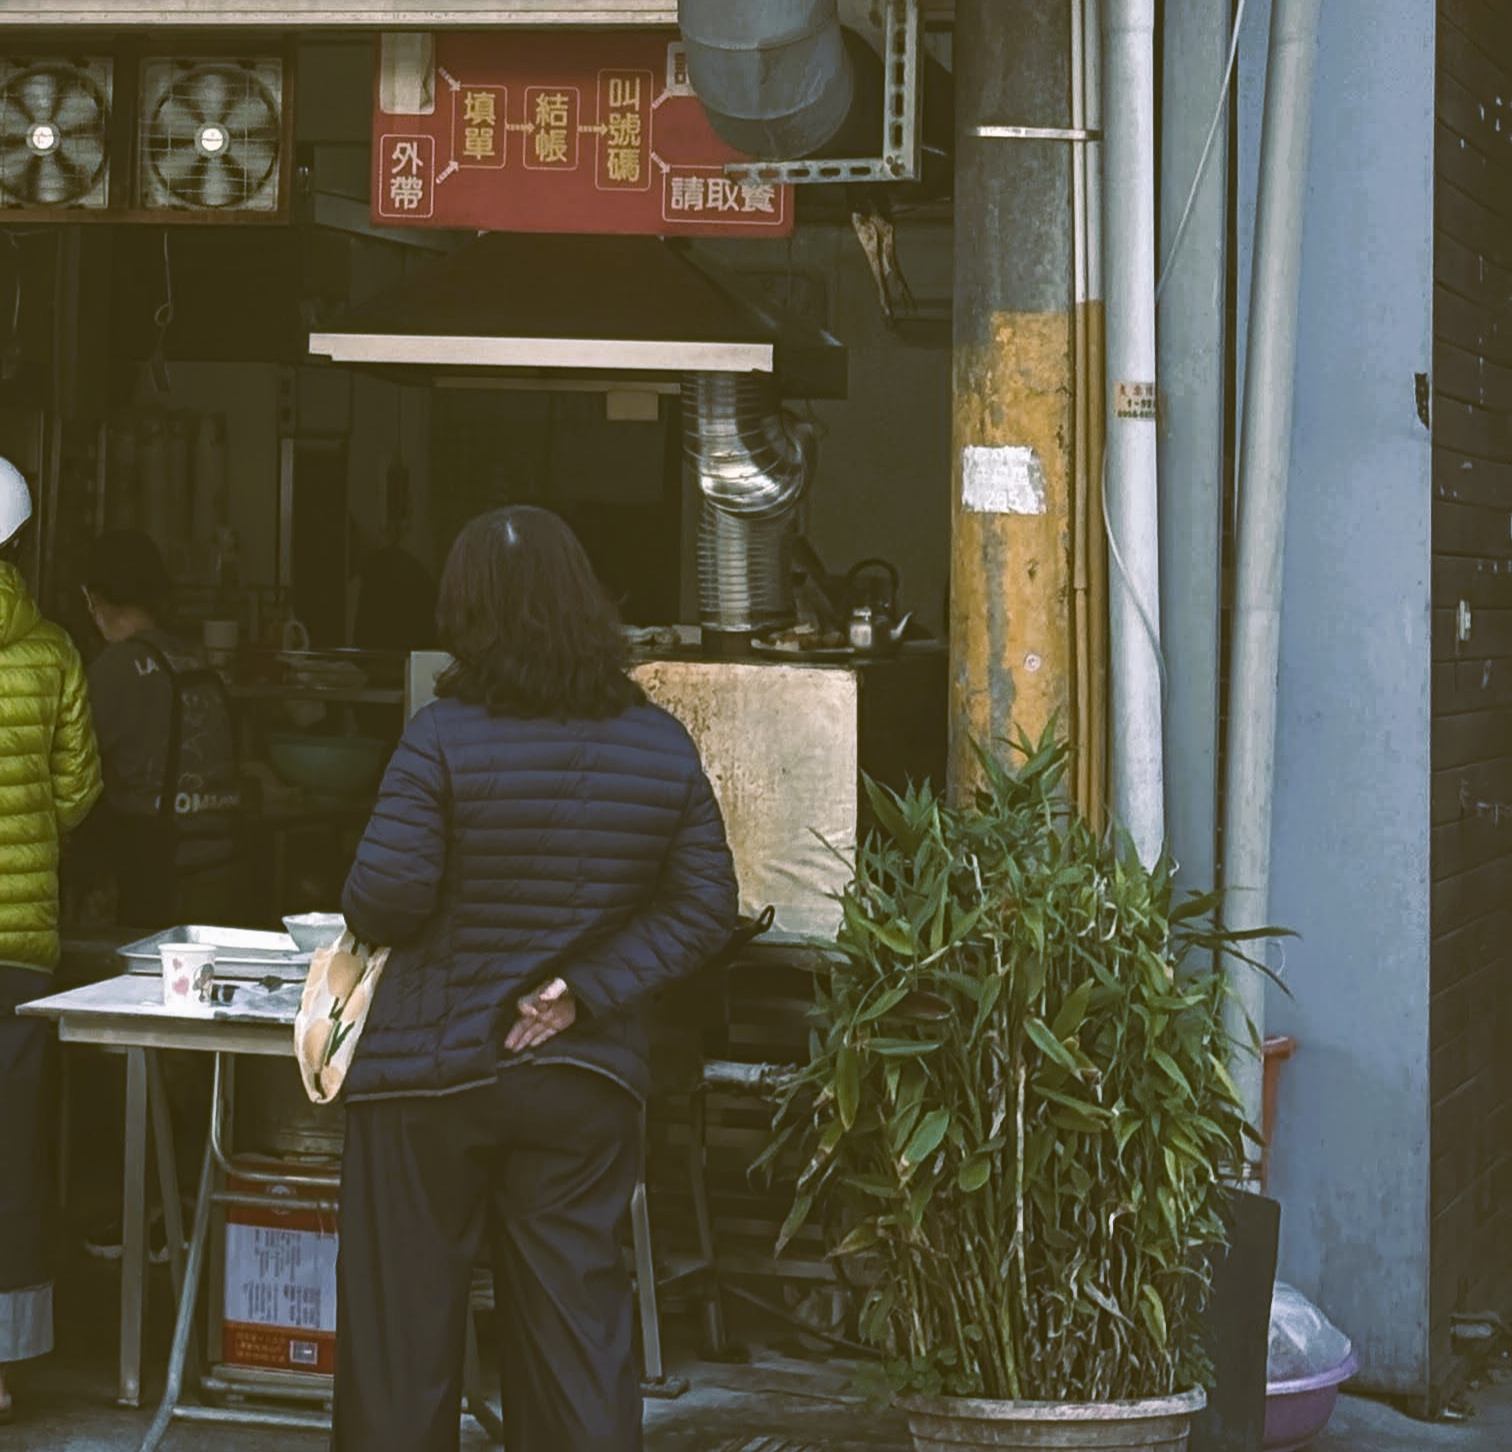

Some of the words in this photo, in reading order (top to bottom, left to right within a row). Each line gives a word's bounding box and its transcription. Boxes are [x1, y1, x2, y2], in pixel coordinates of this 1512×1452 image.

[464, 93, 496, 160] 填單
[535, 94, 568, 163] 結帳
[607, 76, 640, 182] 叫號碼
[390, 142, 424, 211] 外帶
[671, 177, 775, 213] 請取餐
